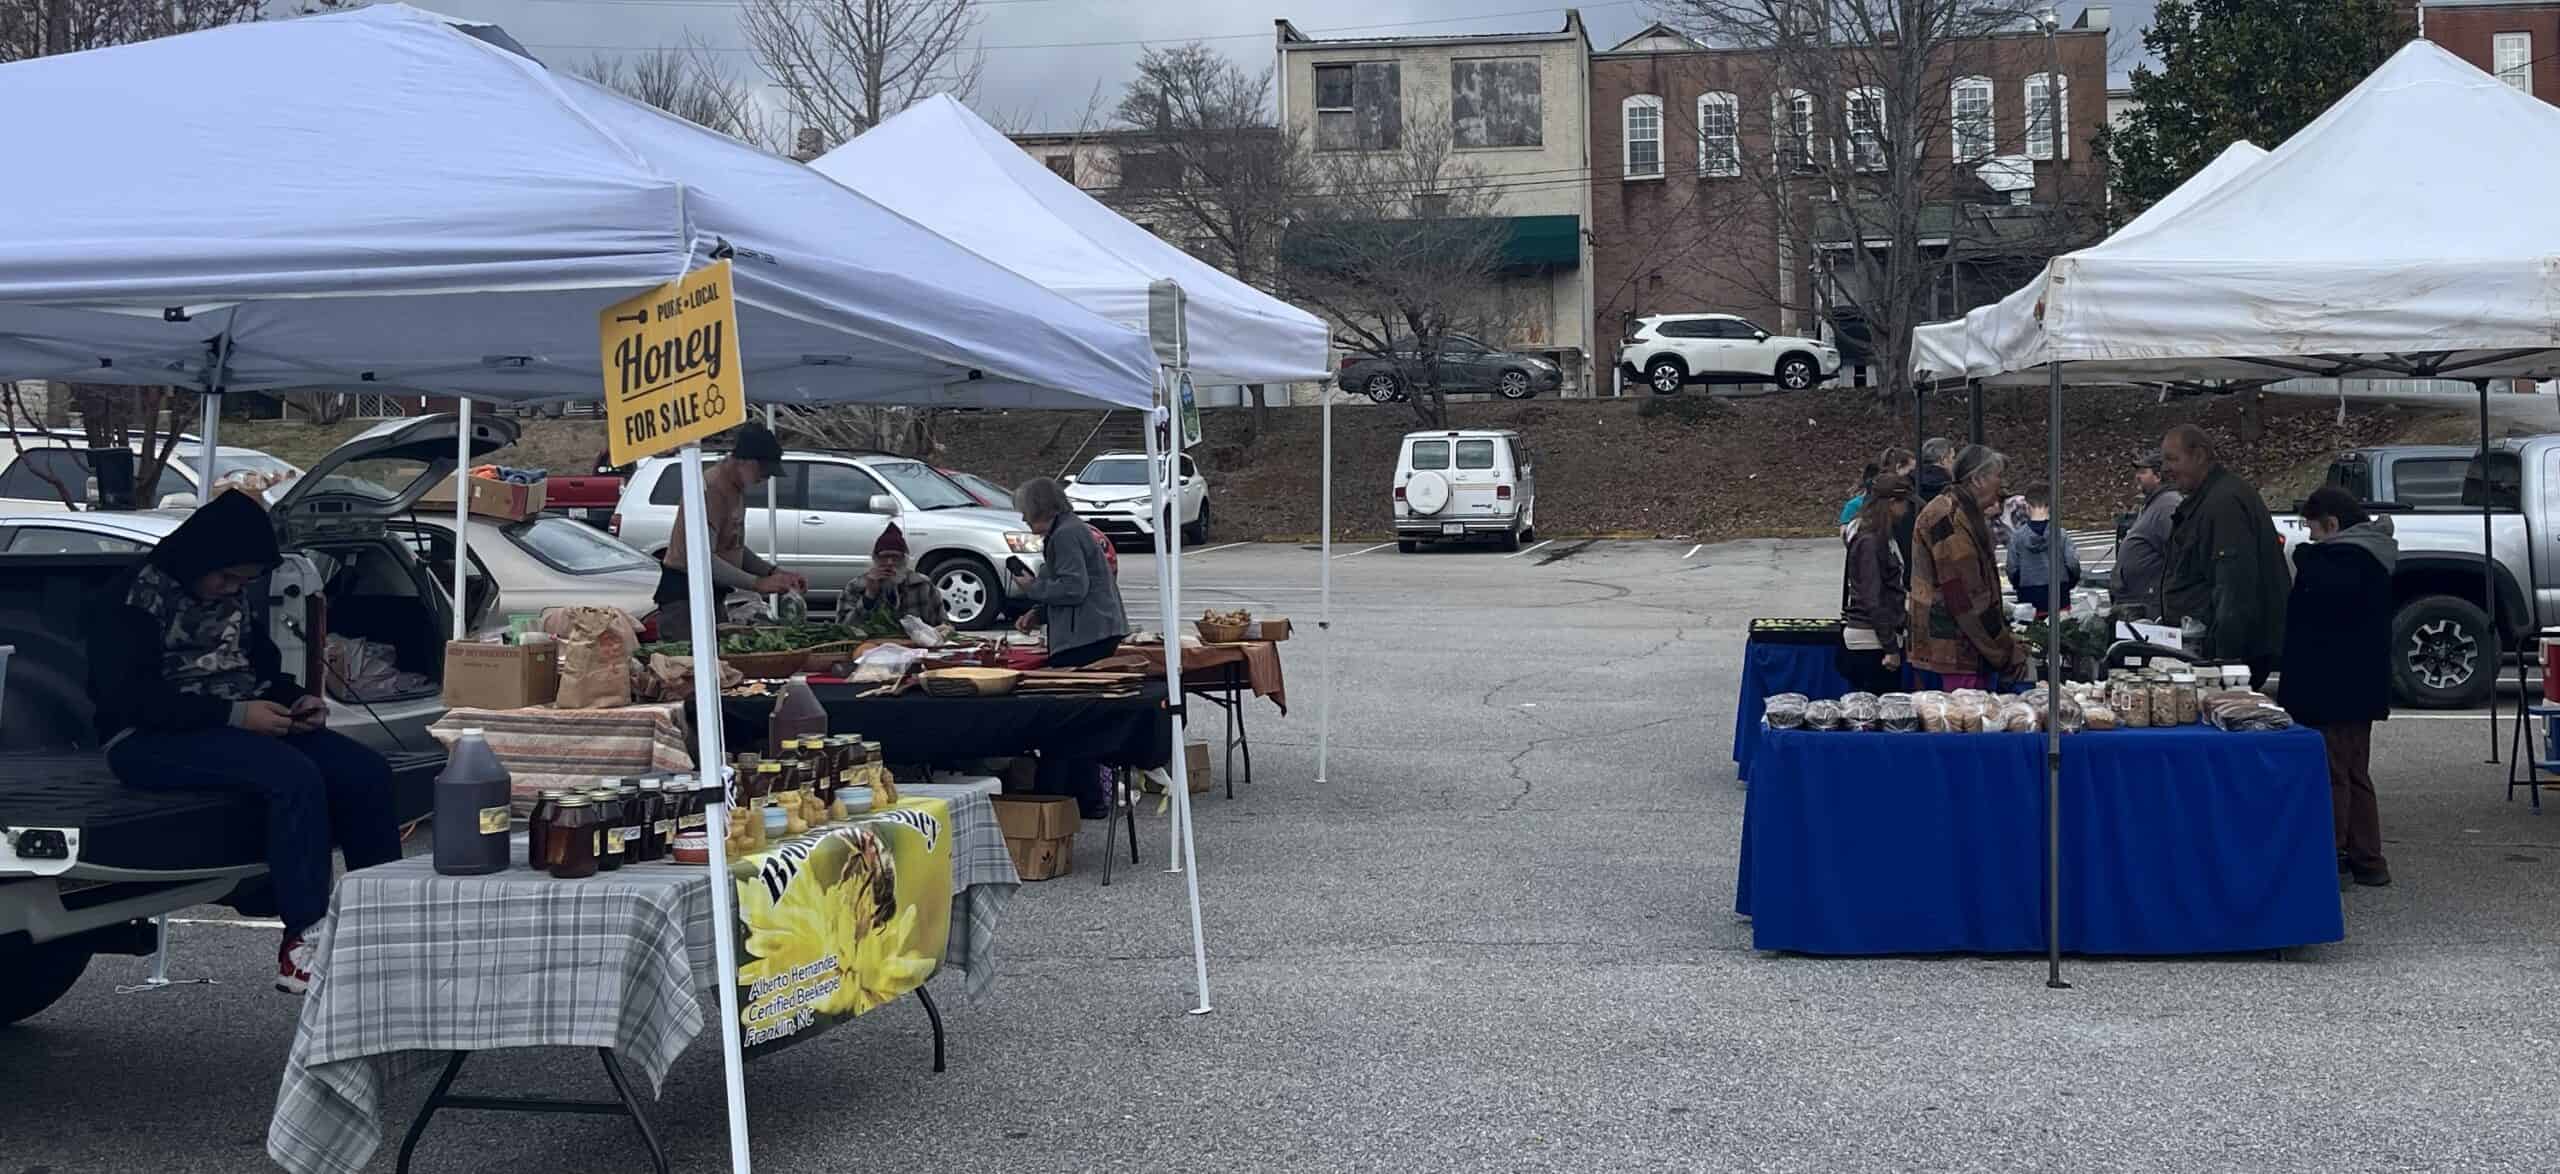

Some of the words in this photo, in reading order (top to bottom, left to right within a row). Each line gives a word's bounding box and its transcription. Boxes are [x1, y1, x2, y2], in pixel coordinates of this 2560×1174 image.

[657, 295, 684, 323] PURE
[689, 282, 720, 310] LOCAL
[614, 319, 723, 395] Honey
[625, 408, 657, 446] FOR
[660, 391, 700, 433] SALE
[748, 974, 789, 1000] Alberto
[790, 953, 838, 983] Hernandez
[748, 992, 796, 1022] Certified
[796, 1006, 816, 1031] NC
